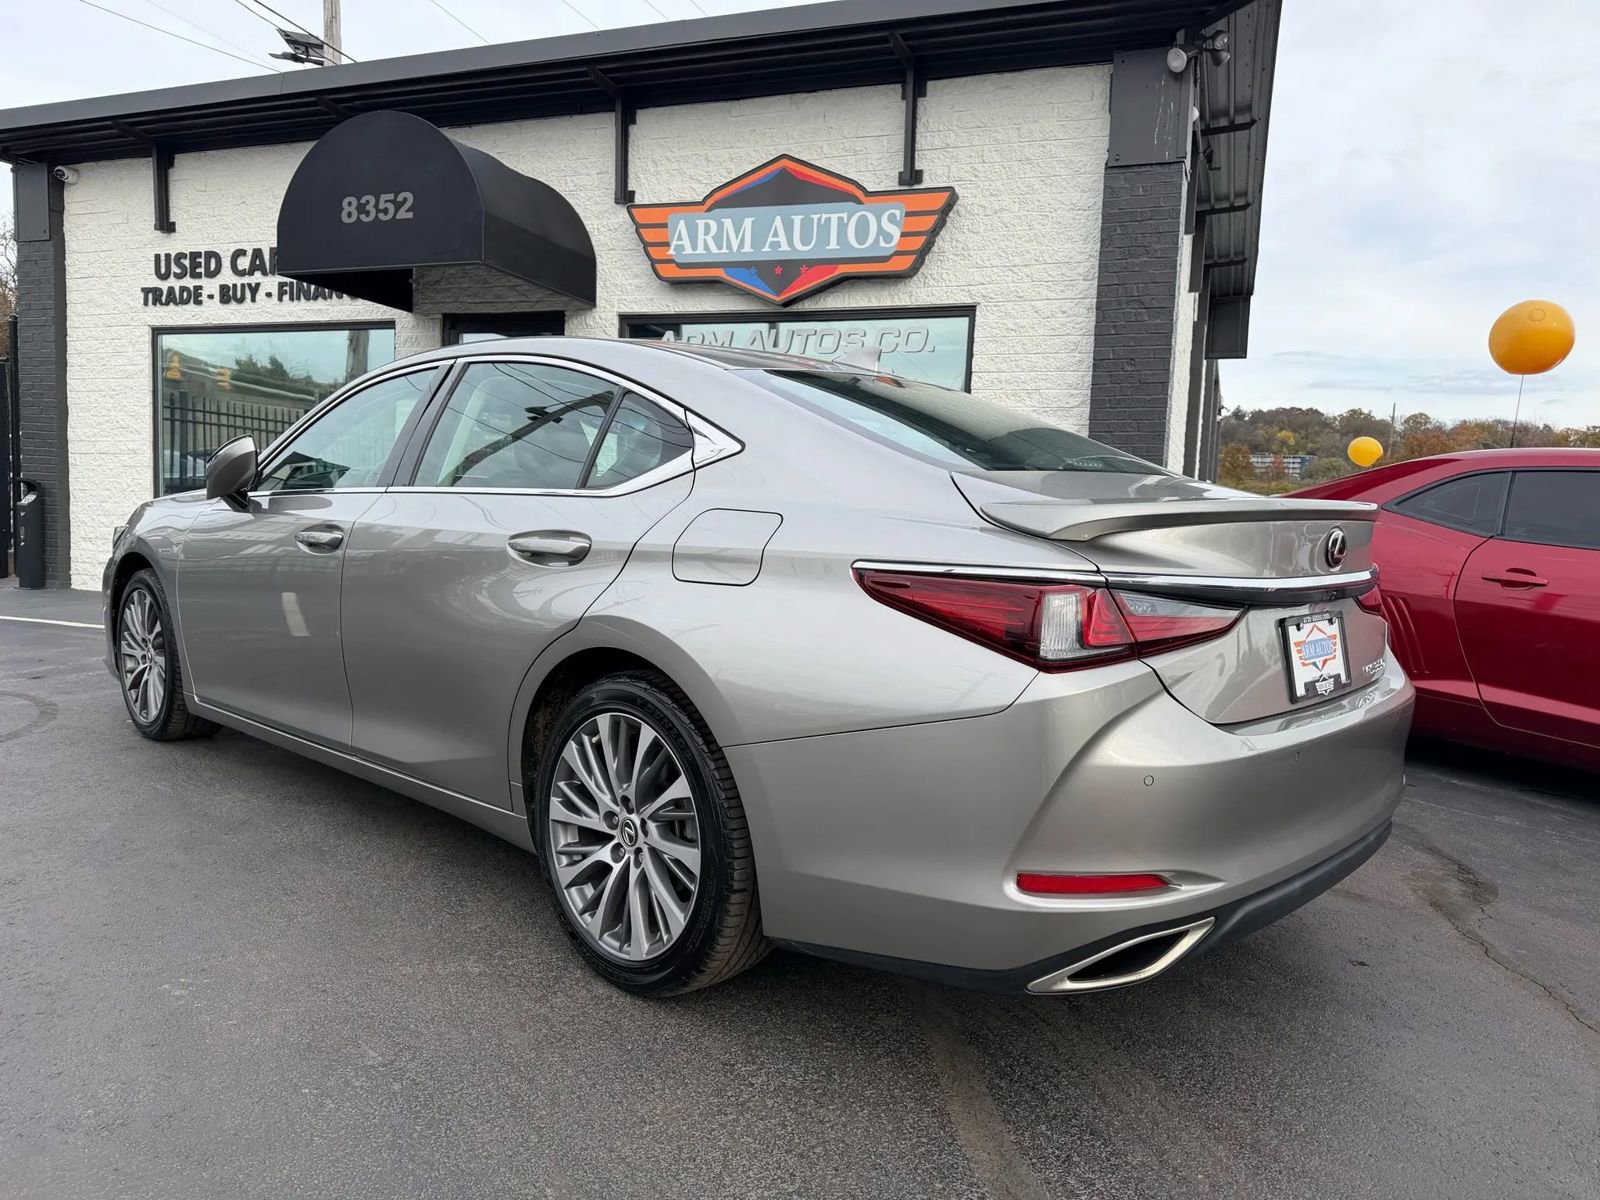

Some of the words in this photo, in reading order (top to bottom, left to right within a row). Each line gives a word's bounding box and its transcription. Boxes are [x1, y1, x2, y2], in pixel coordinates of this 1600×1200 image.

[340, 191, 414, 223] 8352
[666, 217, 755, 255] ARM
[761, 209, 901, 252] AUTOS
[153, 250, 222, 280] USED
[141, 284, 203, 306] TRADE
[219, 282, 261, 304] BUY
[746, 327, 866, 355] AUTOS
[875, 327, 937, 354] CO.
